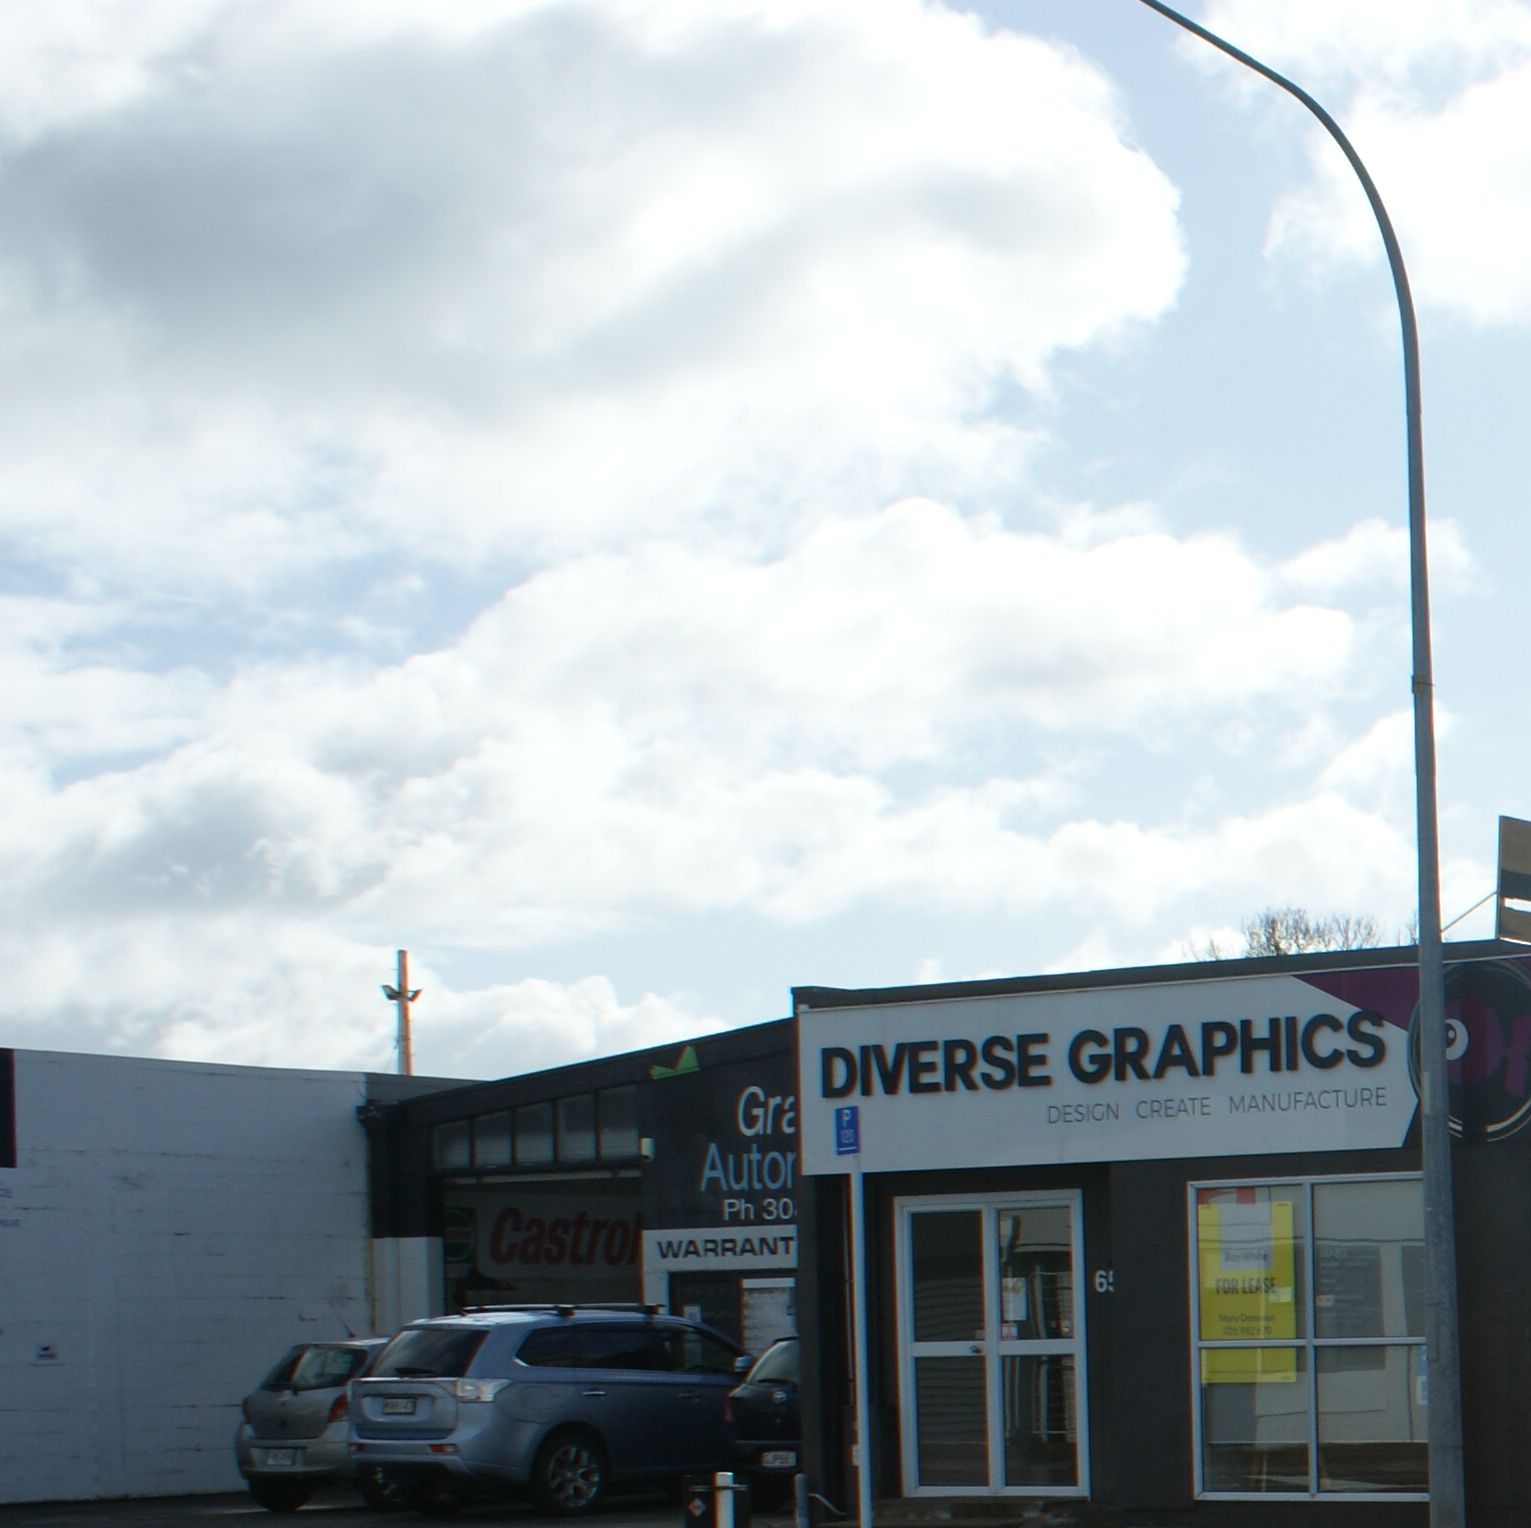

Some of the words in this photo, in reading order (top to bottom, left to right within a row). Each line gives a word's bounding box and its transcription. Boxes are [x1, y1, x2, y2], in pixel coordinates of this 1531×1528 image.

[821, 1032, 1053, 1099] DIVERSE
[1067, 1010, 1387, 1084] GRAPHICS
[1047, 1103, 1120, 1124] DESIGN
[1136, 1097, 1211, 1119] CREATE
[1229, 1086, 1387, 1114] MANUFACTURE
[842, 1109, 853, 1128] P
[724, 1200, 755, 1221] Ph
[762, 1198, 797, 1220] 30
[1216, 1279, 1239, 1295] FOR
[1242, 1276, 1277, 1294] LEASE
